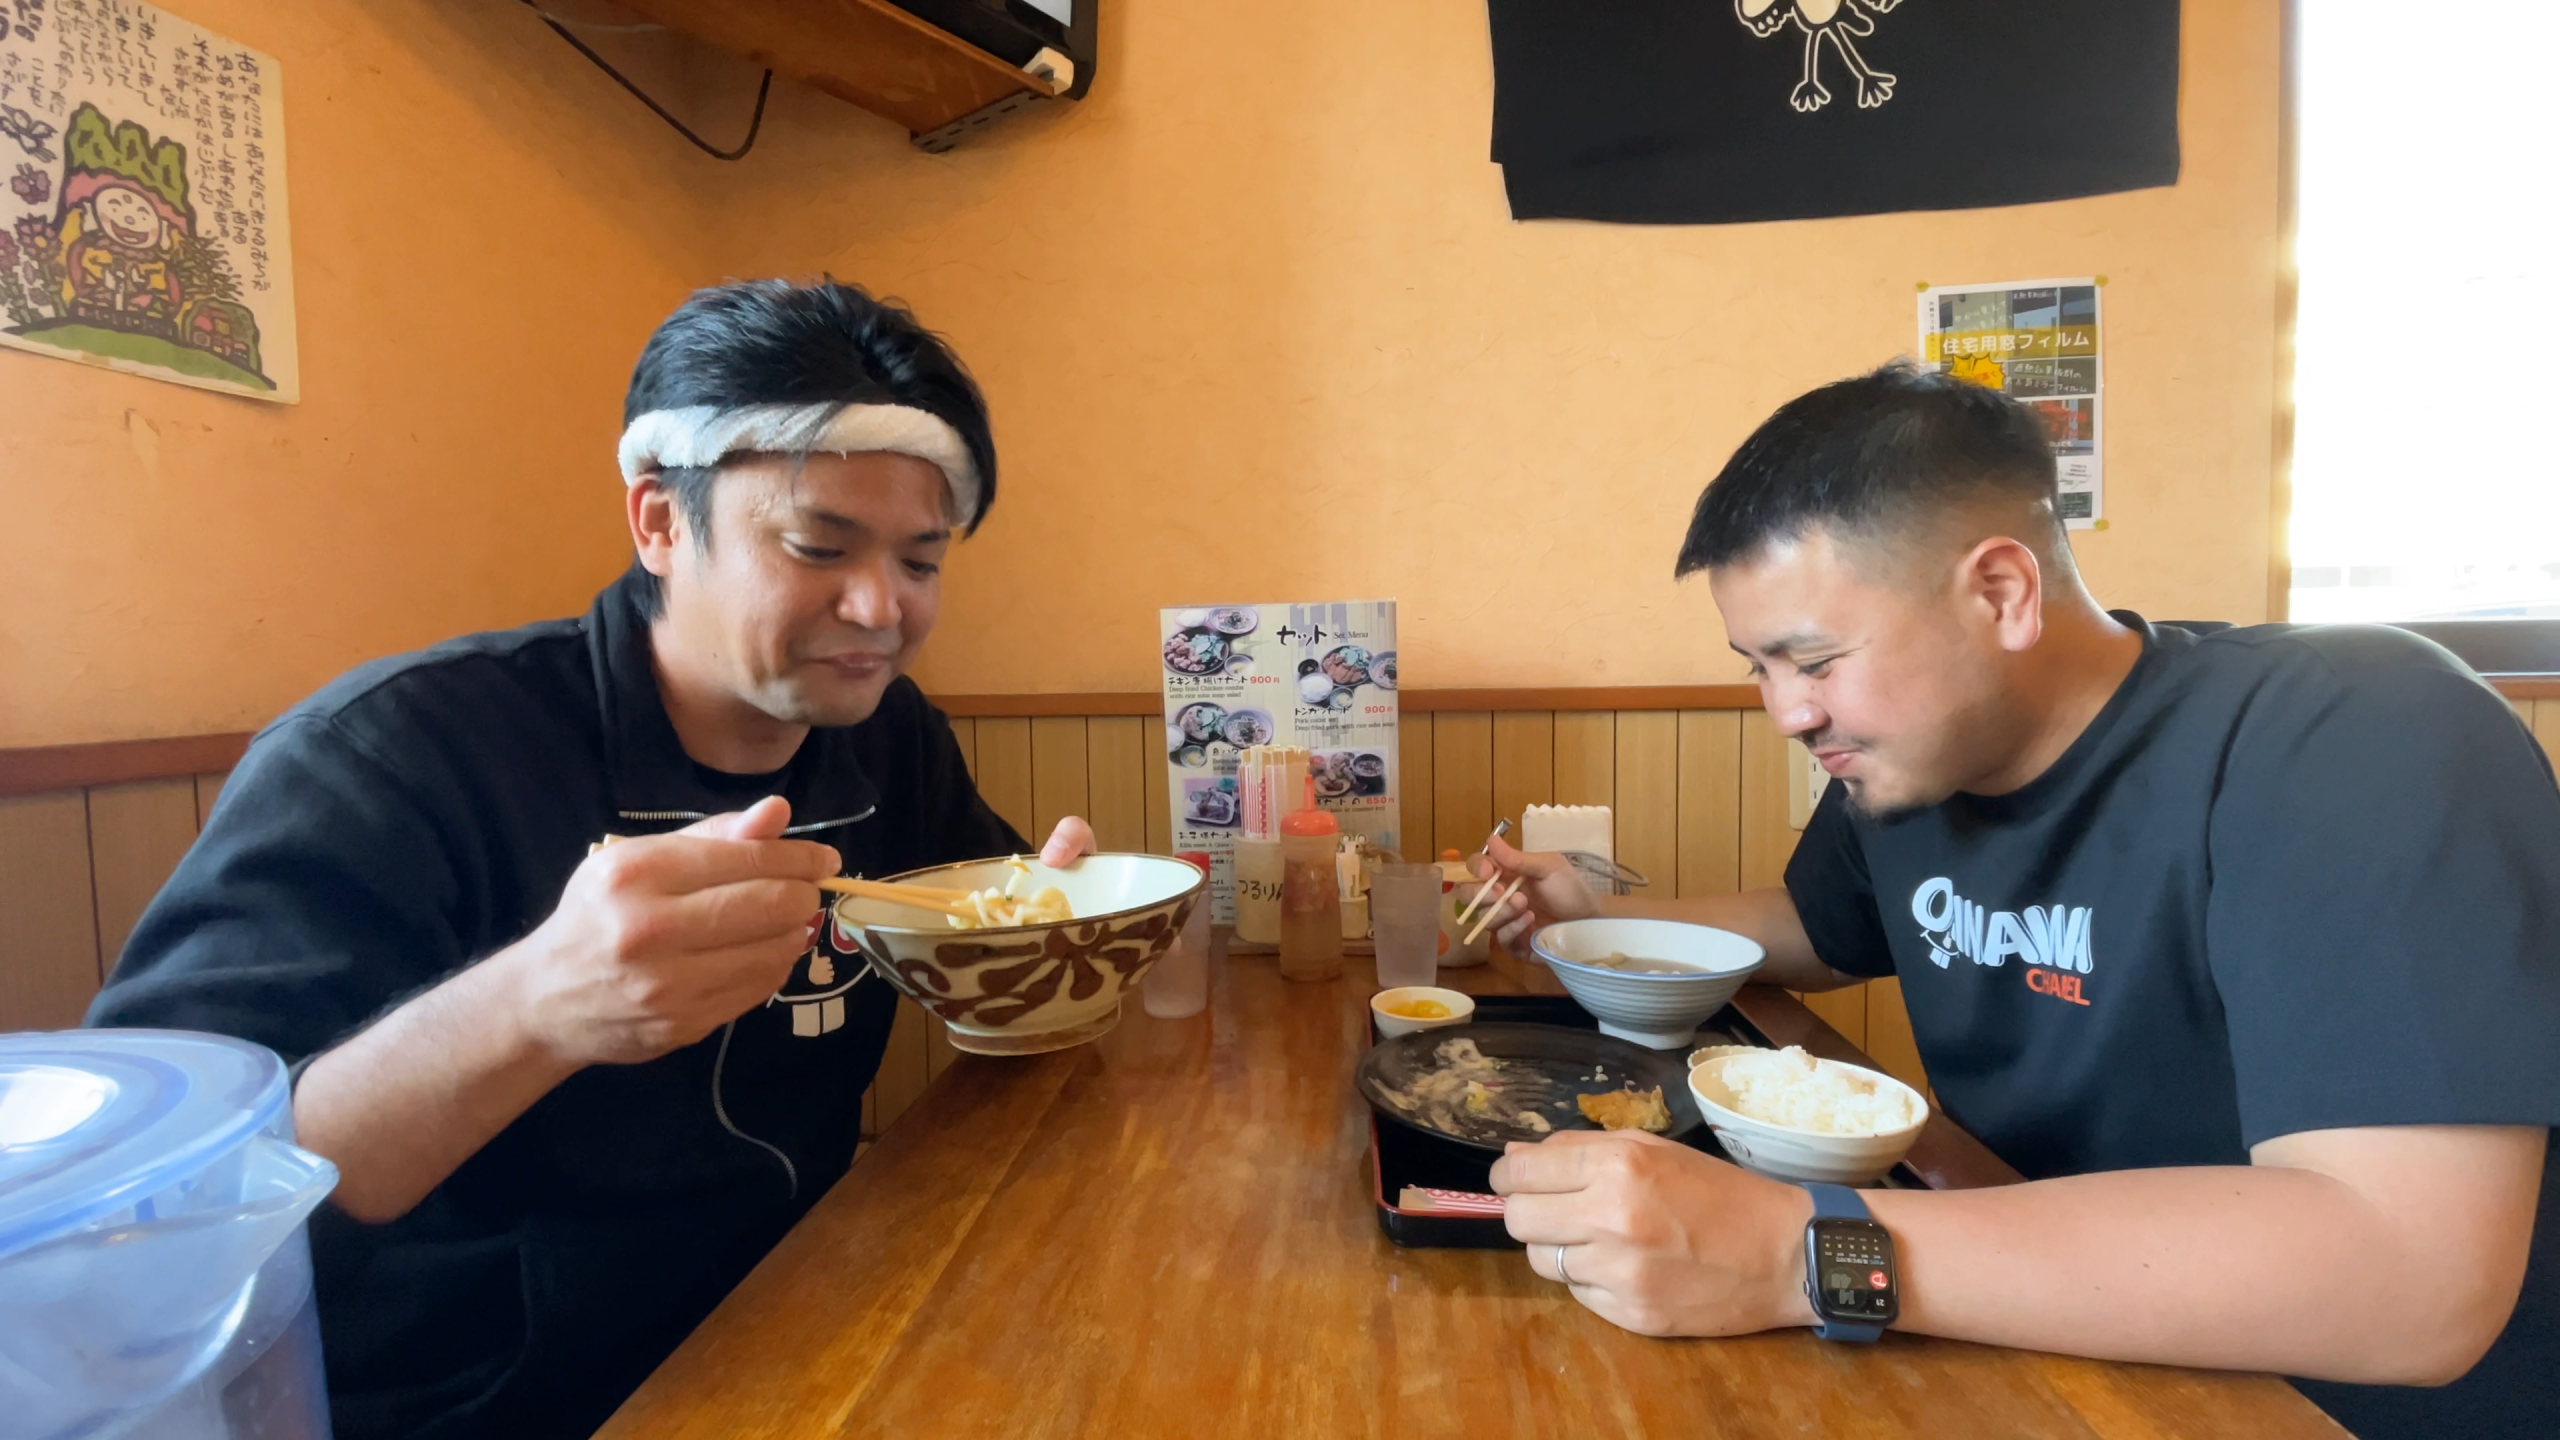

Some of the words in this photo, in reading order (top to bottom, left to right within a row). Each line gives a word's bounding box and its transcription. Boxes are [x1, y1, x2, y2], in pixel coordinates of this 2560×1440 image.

[1942, 331, 2089, 355] 住宅用窓フィルム
[1276, 622, 1327, 647] セット
